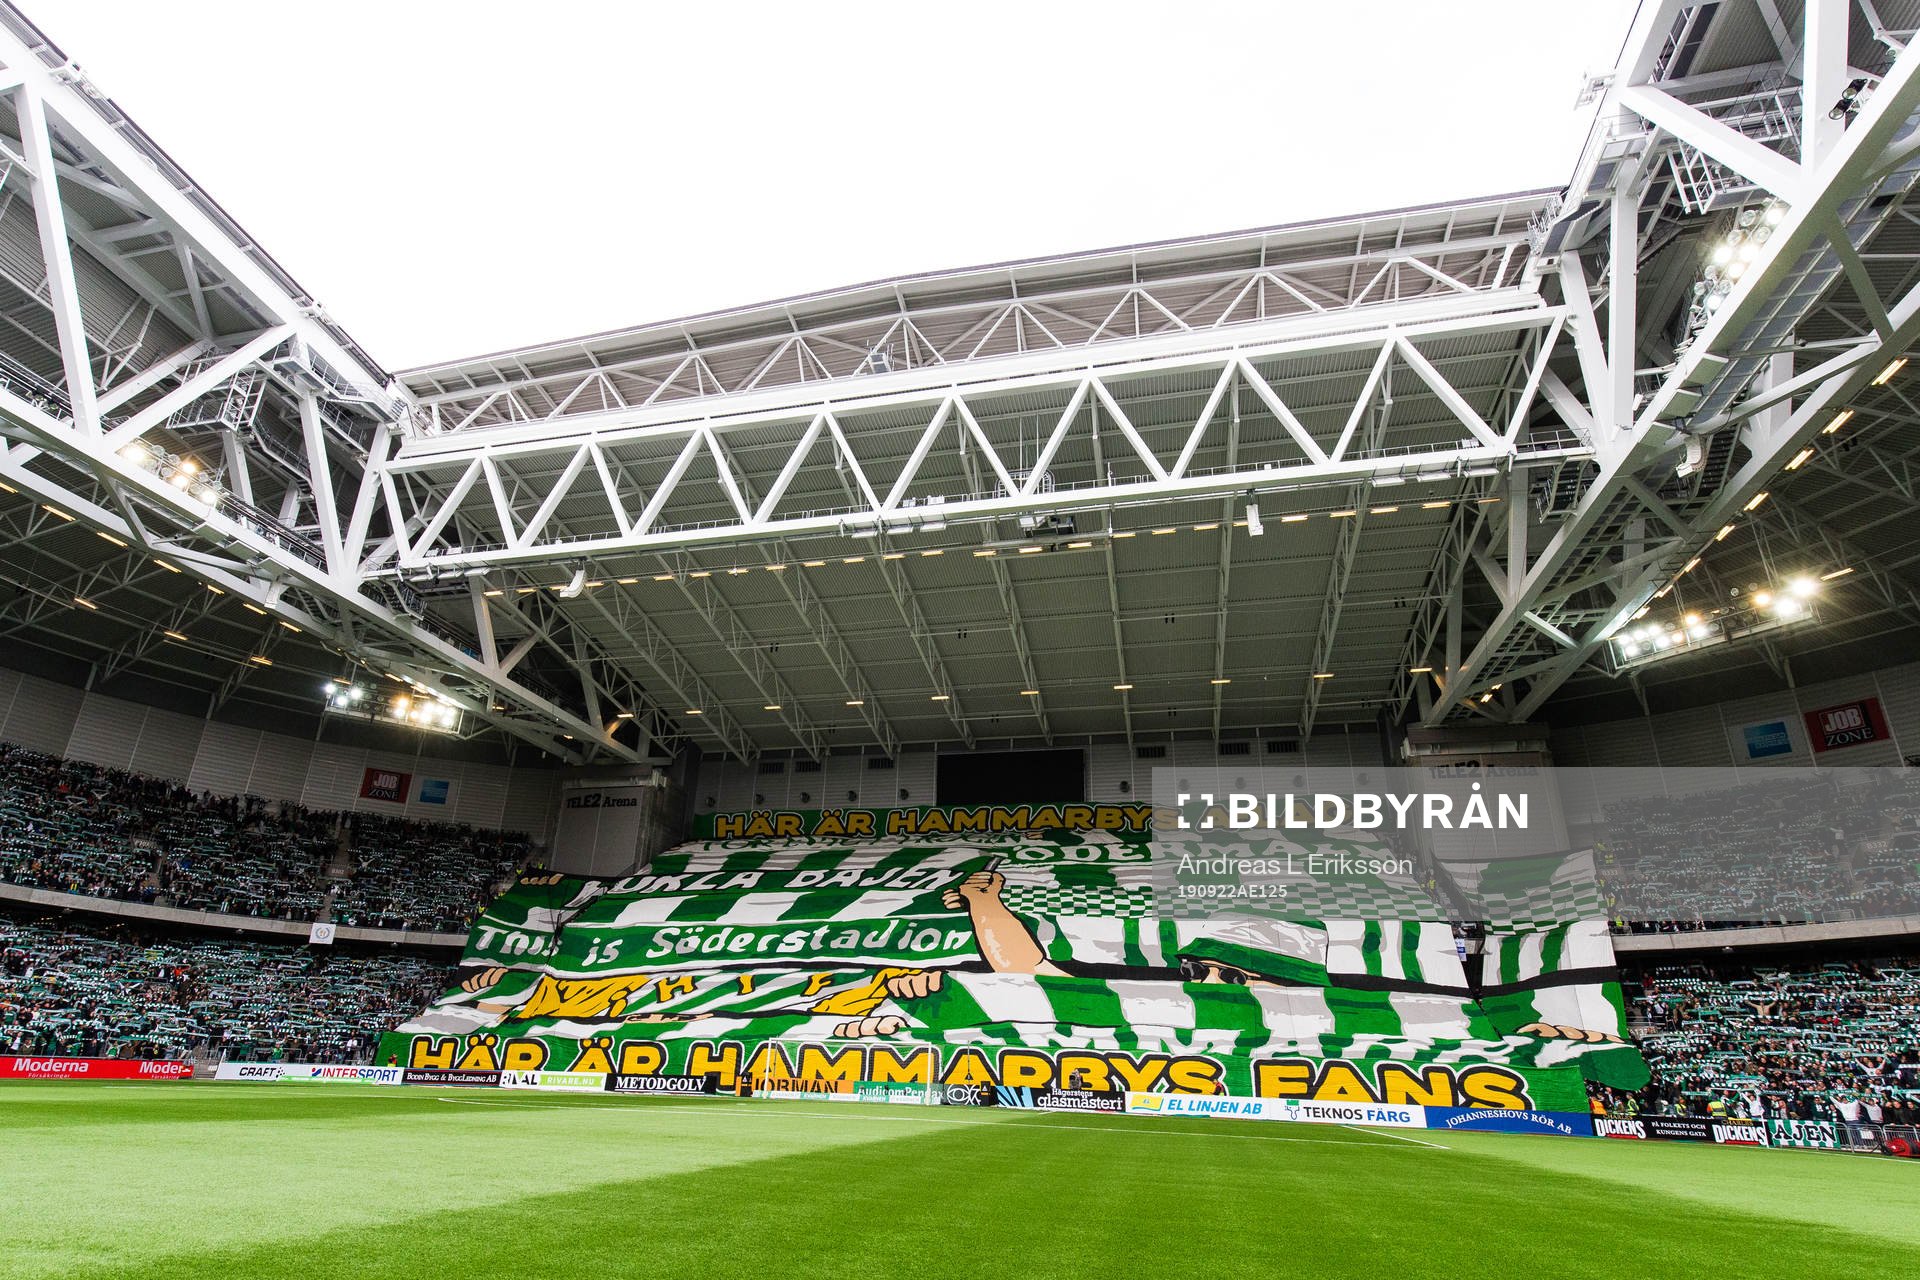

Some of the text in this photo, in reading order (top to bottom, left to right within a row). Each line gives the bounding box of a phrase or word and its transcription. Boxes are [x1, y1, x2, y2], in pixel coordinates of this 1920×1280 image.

[1825, 708, 1862, 732] JOB
[1826, 727, 1875, 747] ZONE
[1429, 760, 1538, 779] TELE2 Arena
[373, 774, 399, 789] JOB
[368, 788, 400, 801] ZONE
[566, 792, 637, 809] TELE2 Arena
[715, 808, 803, 838] HÄR
[814, 807, 875, 836] ÄR
[886, 804, 1180, 835] HAMMARBYS
[475, 918, 973, 967] This is Söderstadion
[13, 1058, 89, 1073] Moderna
[239, 1067, 276, 1077] CRAFT
[322, 1067, 398, 1082] INTERSPORT
[408, 1034, 1535, 1111] HÄR ÄR HAMMARBYS FANS
[440, 1073, 447, 1081] &
[486, 1074, 497, 1083] AB
[615, 1076, 707, 1092] METODGOLV
[1038, 1093, 1123, 1111] glasmästeri
[1168, 1099, 1263, 1115] EL LINJEN AB
[1303, 1106, 1411, 1123] TEKNOS FÄRG
[1446, 1109, 1572, 1134] JOHANNESHOVS RÖR AB
[1594, 1118, 1647, 1139] DICKENS
[1712, 1124, 1767, 1147] DICKENS
[1773, 1124, 1837, 1142] AJEN
